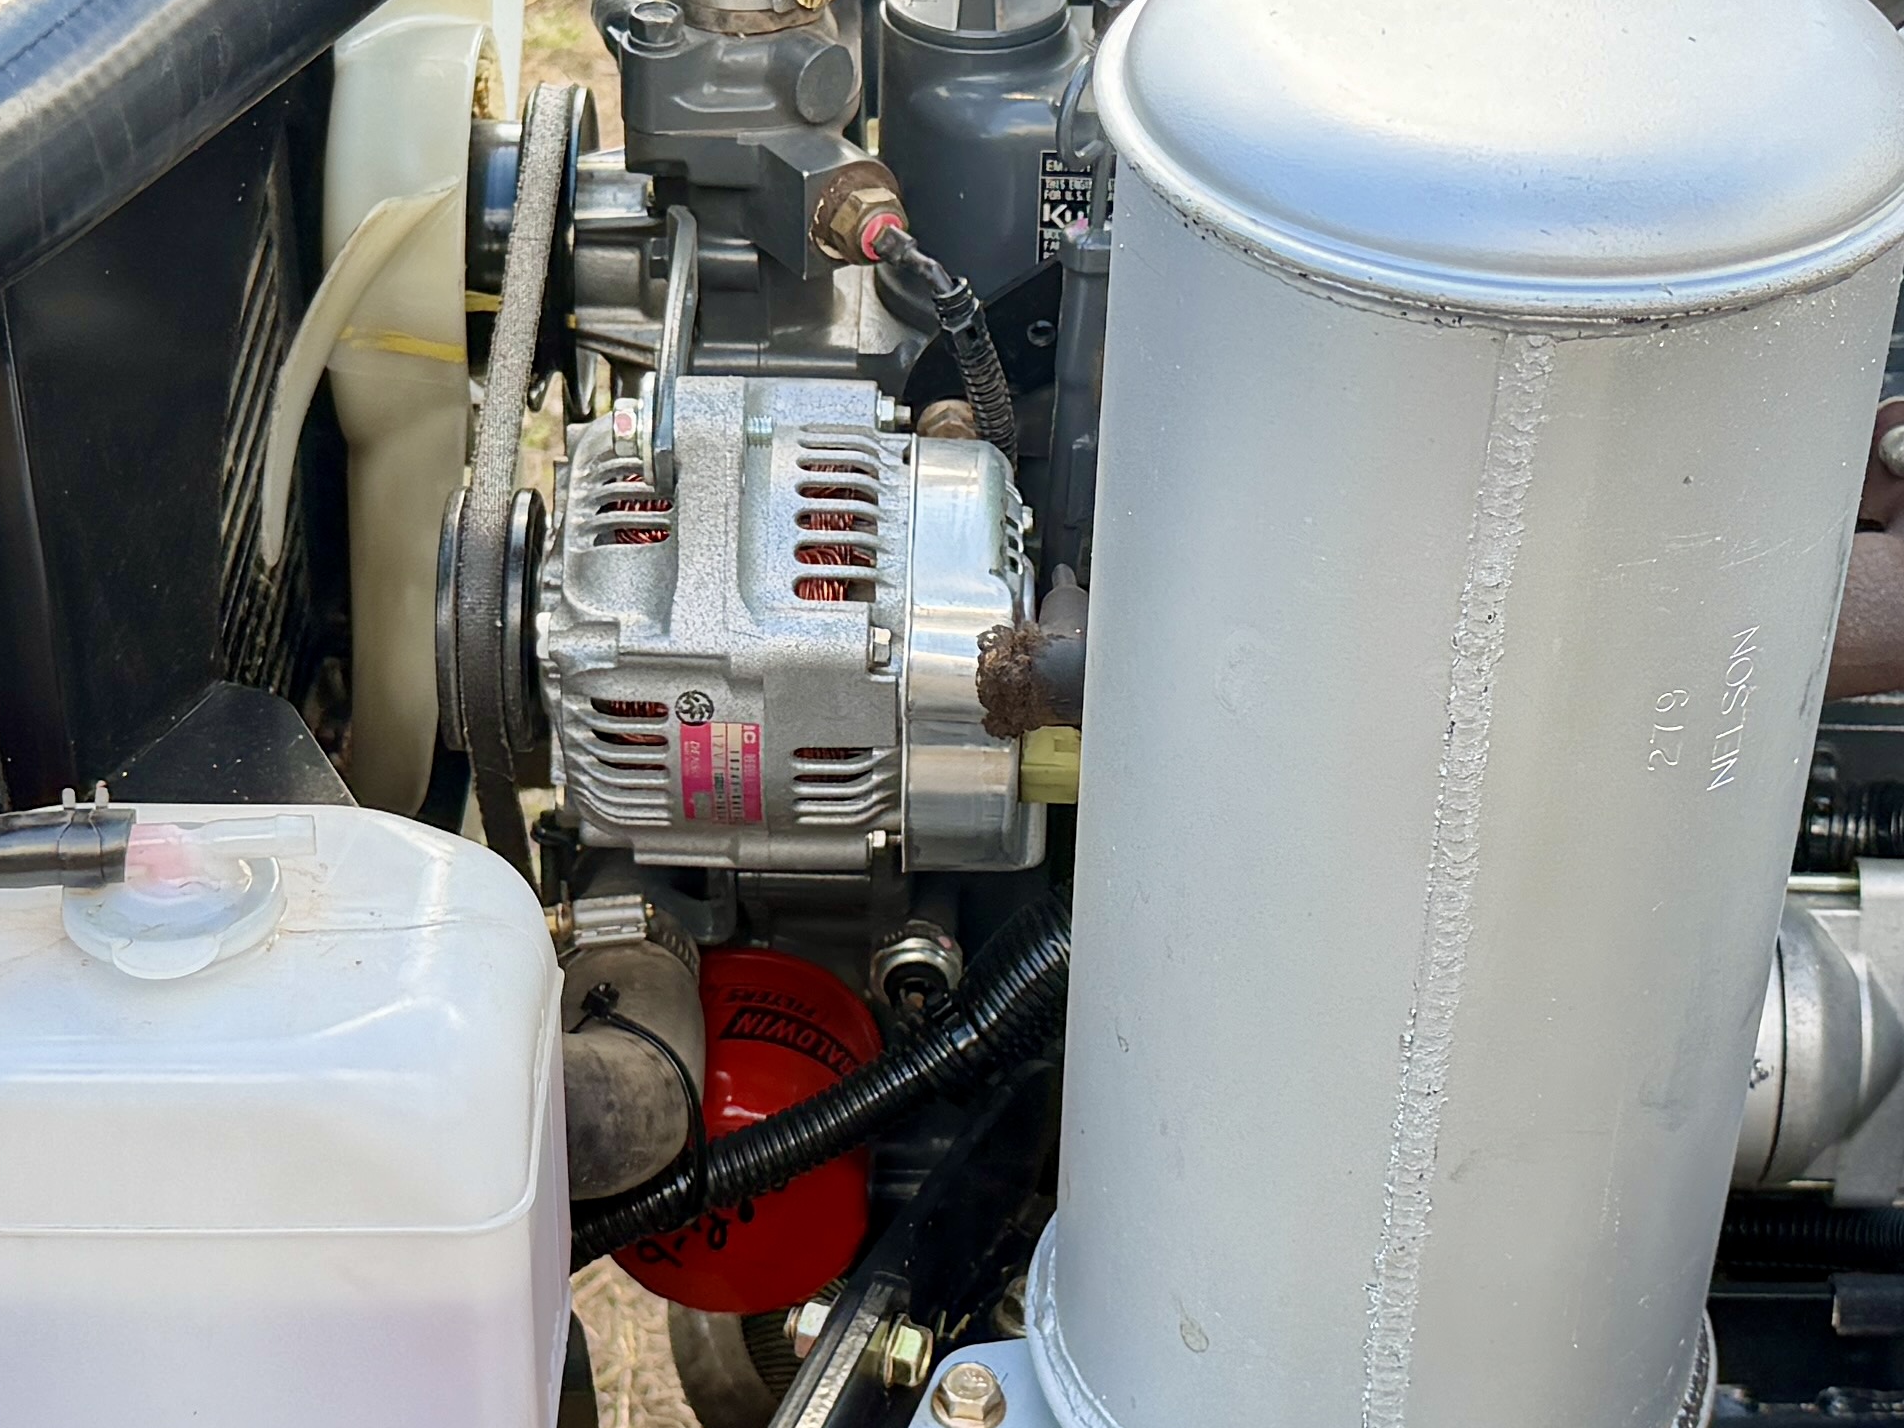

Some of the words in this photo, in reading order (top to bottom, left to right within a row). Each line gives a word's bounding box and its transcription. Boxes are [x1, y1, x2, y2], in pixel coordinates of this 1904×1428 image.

[1645, 687, 1690, 772] 279
[1706, 624, 1762, 792] NELSON
[733, 1012, 858, 1076] BALDWIN
